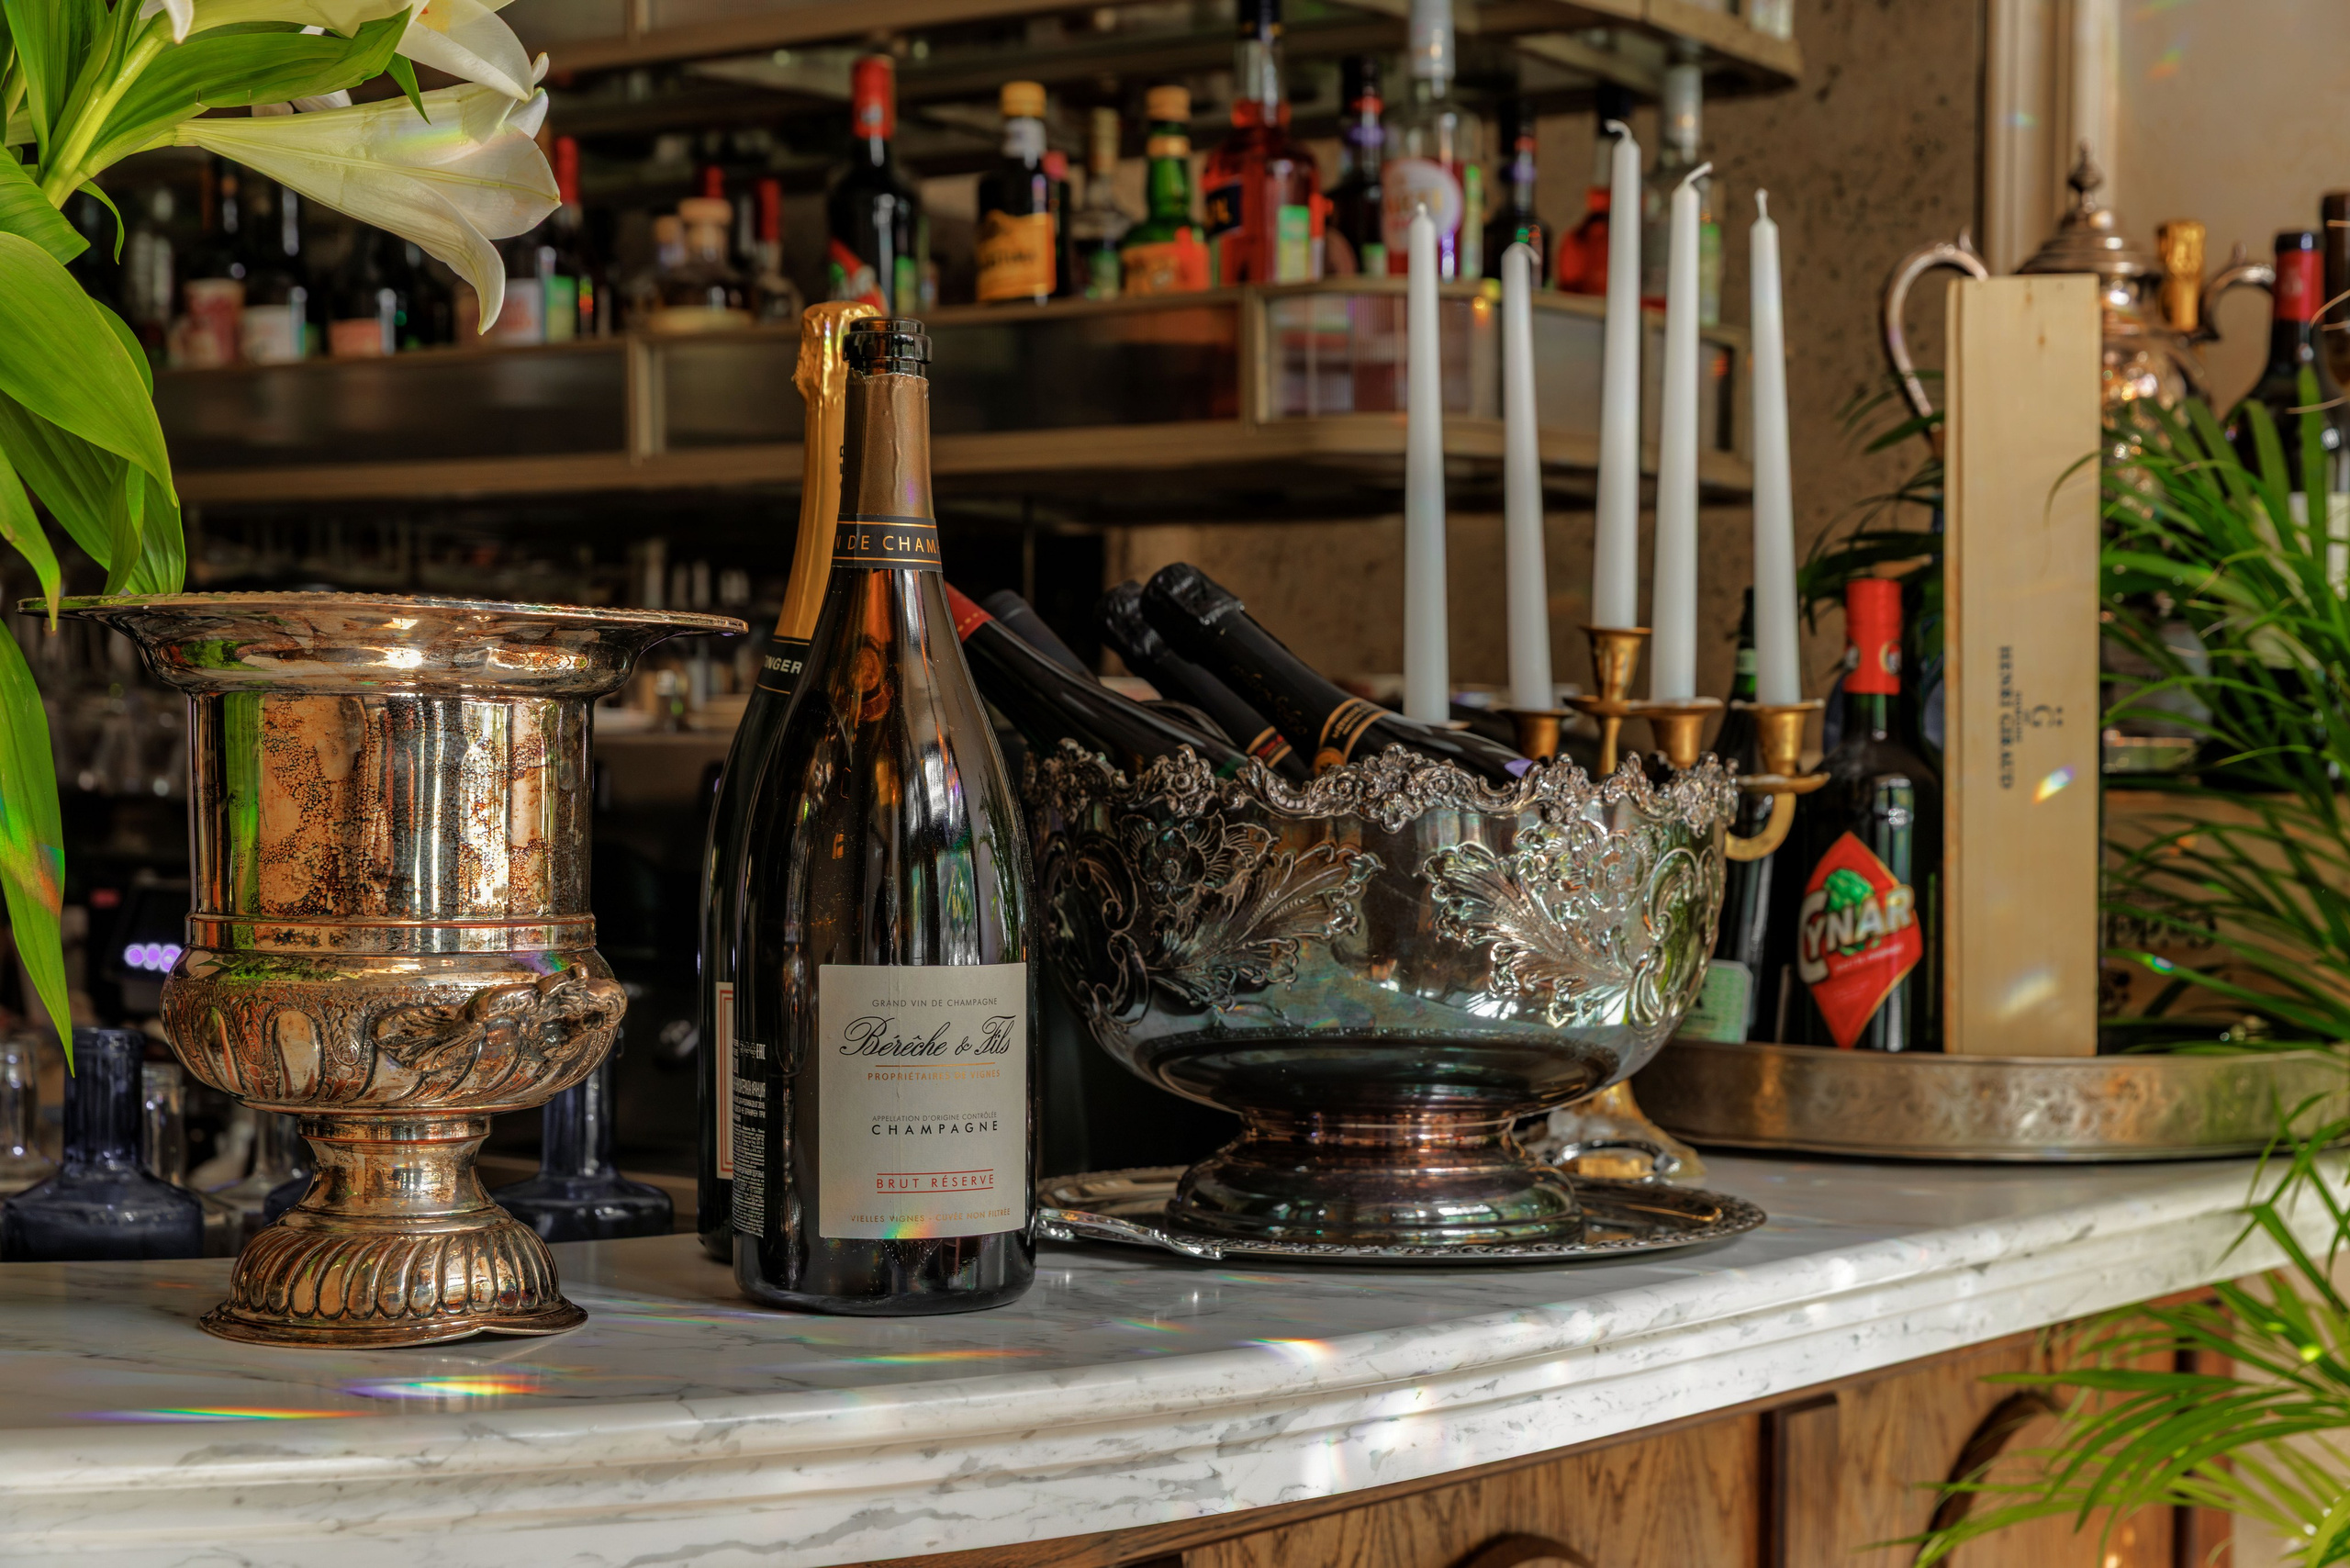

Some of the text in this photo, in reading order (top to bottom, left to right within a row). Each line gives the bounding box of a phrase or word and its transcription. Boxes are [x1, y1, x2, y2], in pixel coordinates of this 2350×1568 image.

[847, 534, 870, 550] DE
[1797, 883, 1916, 984] CYNAR
[871, 997, 998, 1008] GRAND VIN DE CHAMPAGNE
[839, 1014, 1016, 1057] Bérêche & Fils
[867, 1069, 1001, 1081] PROPRIÉTAIRES DE VIGNES
[962, 1111, 997, 1120] CONTRÔLÉE
[872, 1120, 998, 1136] CHAMPAGNE
[877, 1174, 994, 1189] BRUT RÉSERVE
[890, 1215, 924, 1223] VIGNES
[935, 1211, 963, 1221] CUVÉE
[967, 1211, 986, 1220] NON
[988, 1207, 1011, 1218] FILTRÉE
